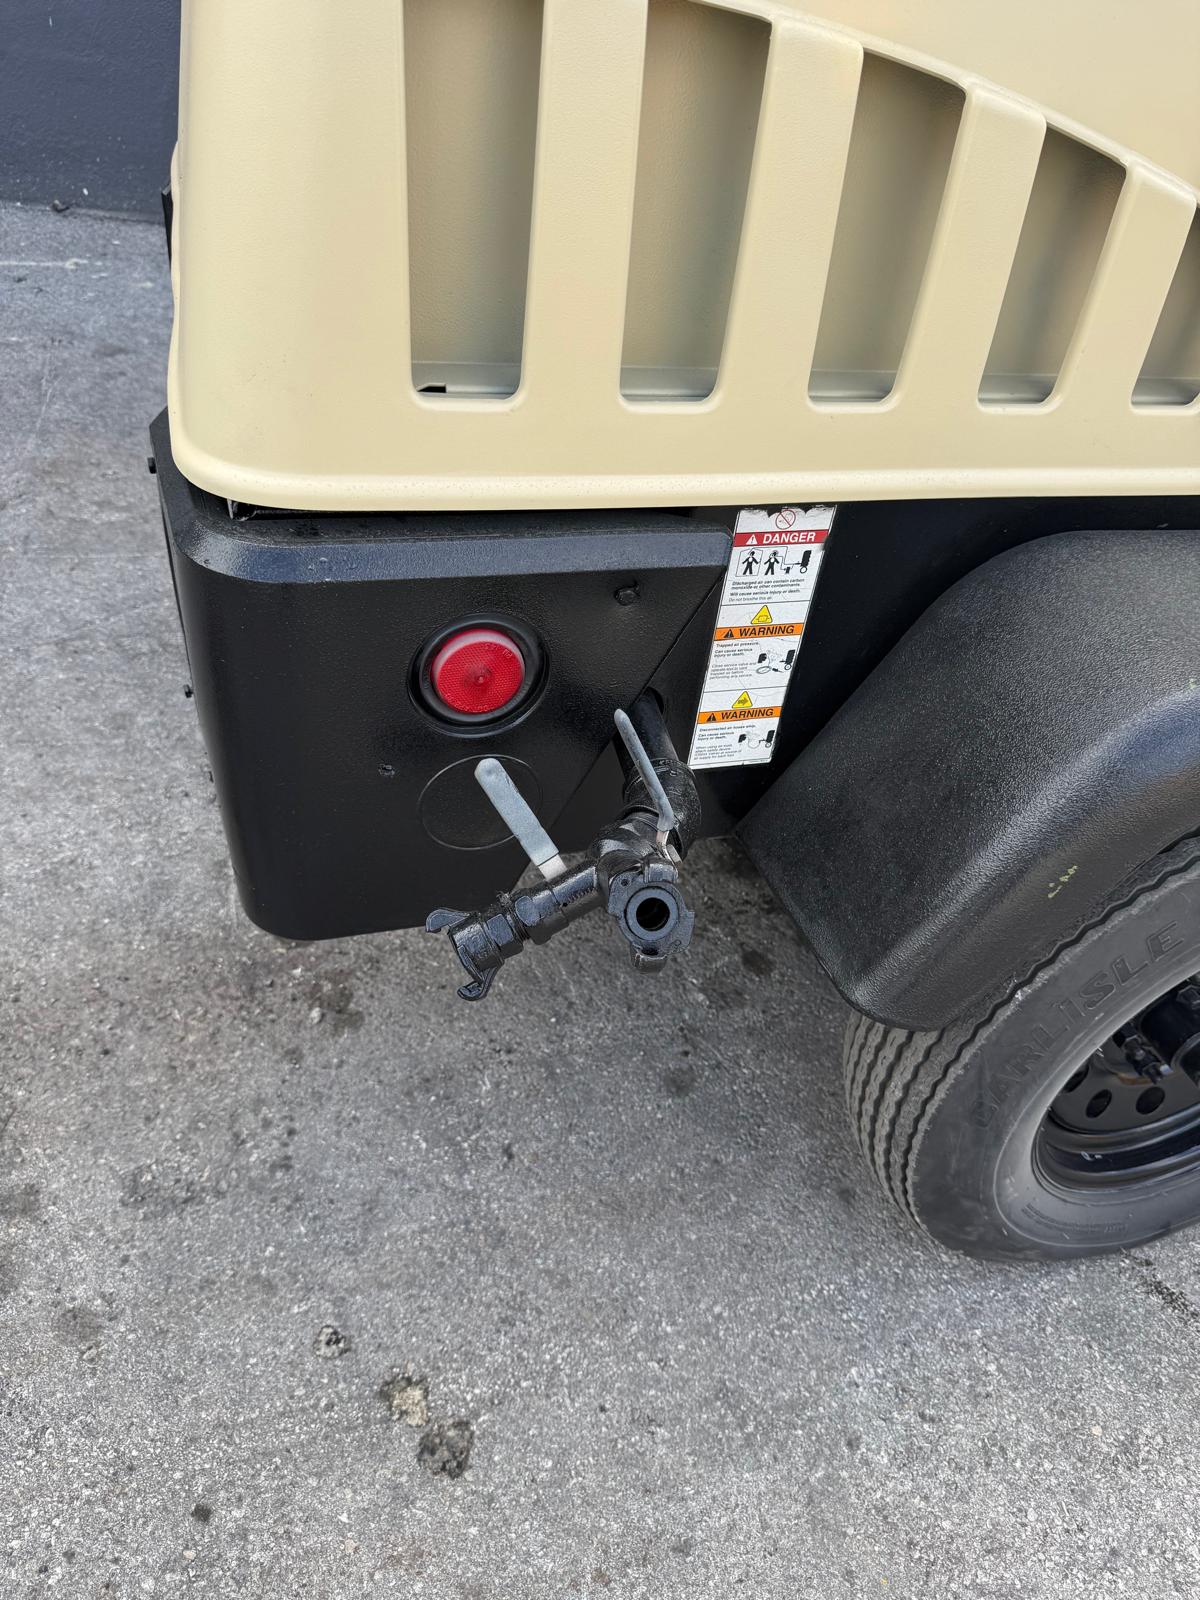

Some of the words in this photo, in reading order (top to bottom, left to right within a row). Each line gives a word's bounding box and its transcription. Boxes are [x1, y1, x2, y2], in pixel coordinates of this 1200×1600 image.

[763, 532, 816, 544] DANGER
[739, 625, 795, 637] WARNING
[721, 708, 774, 720] WARNING
[971, 920, 1184, 1129] CARLISLE
